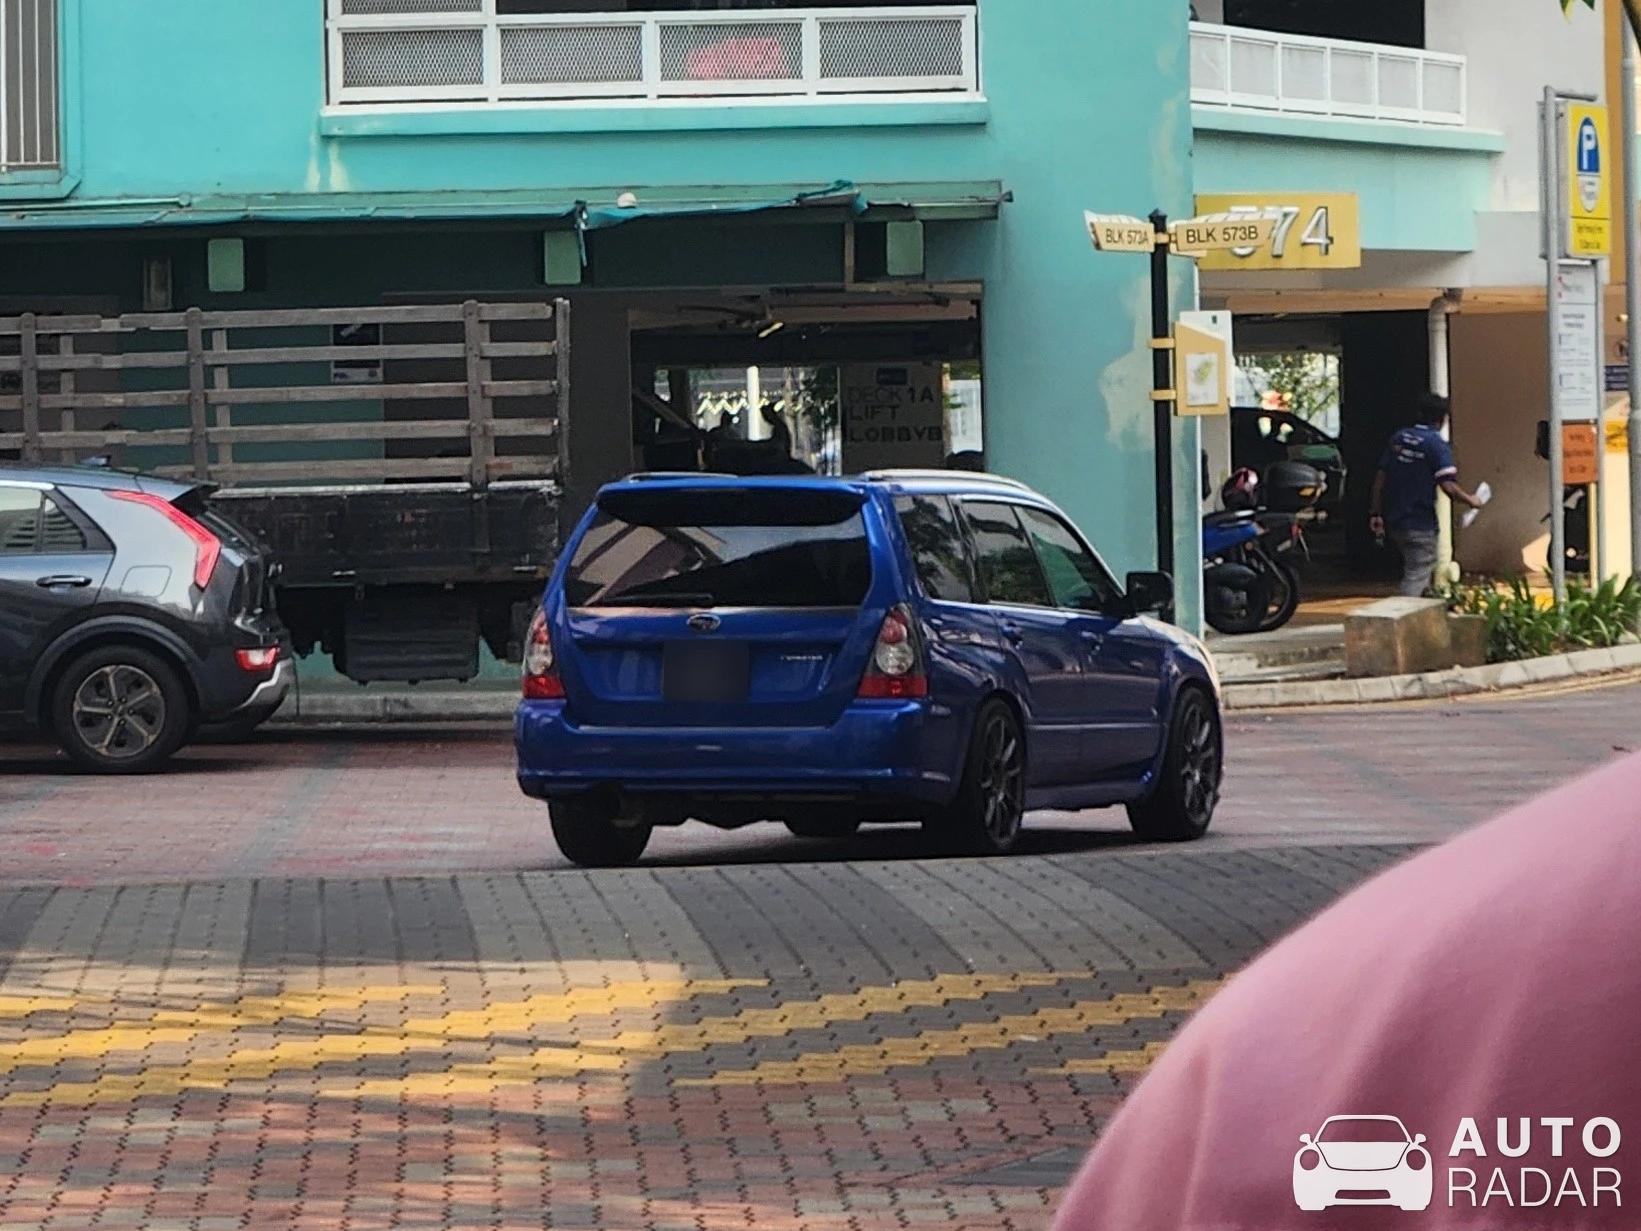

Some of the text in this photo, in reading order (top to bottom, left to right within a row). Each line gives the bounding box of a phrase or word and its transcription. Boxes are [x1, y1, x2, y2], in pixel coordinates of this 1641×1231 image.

[1581, 124, 1596, 170] P
[1105, 229, 1149, 245] BLK 573A
[1185, 225, 1259, 244] BLK 573B
[849, 404, 900, 421] LIFT
